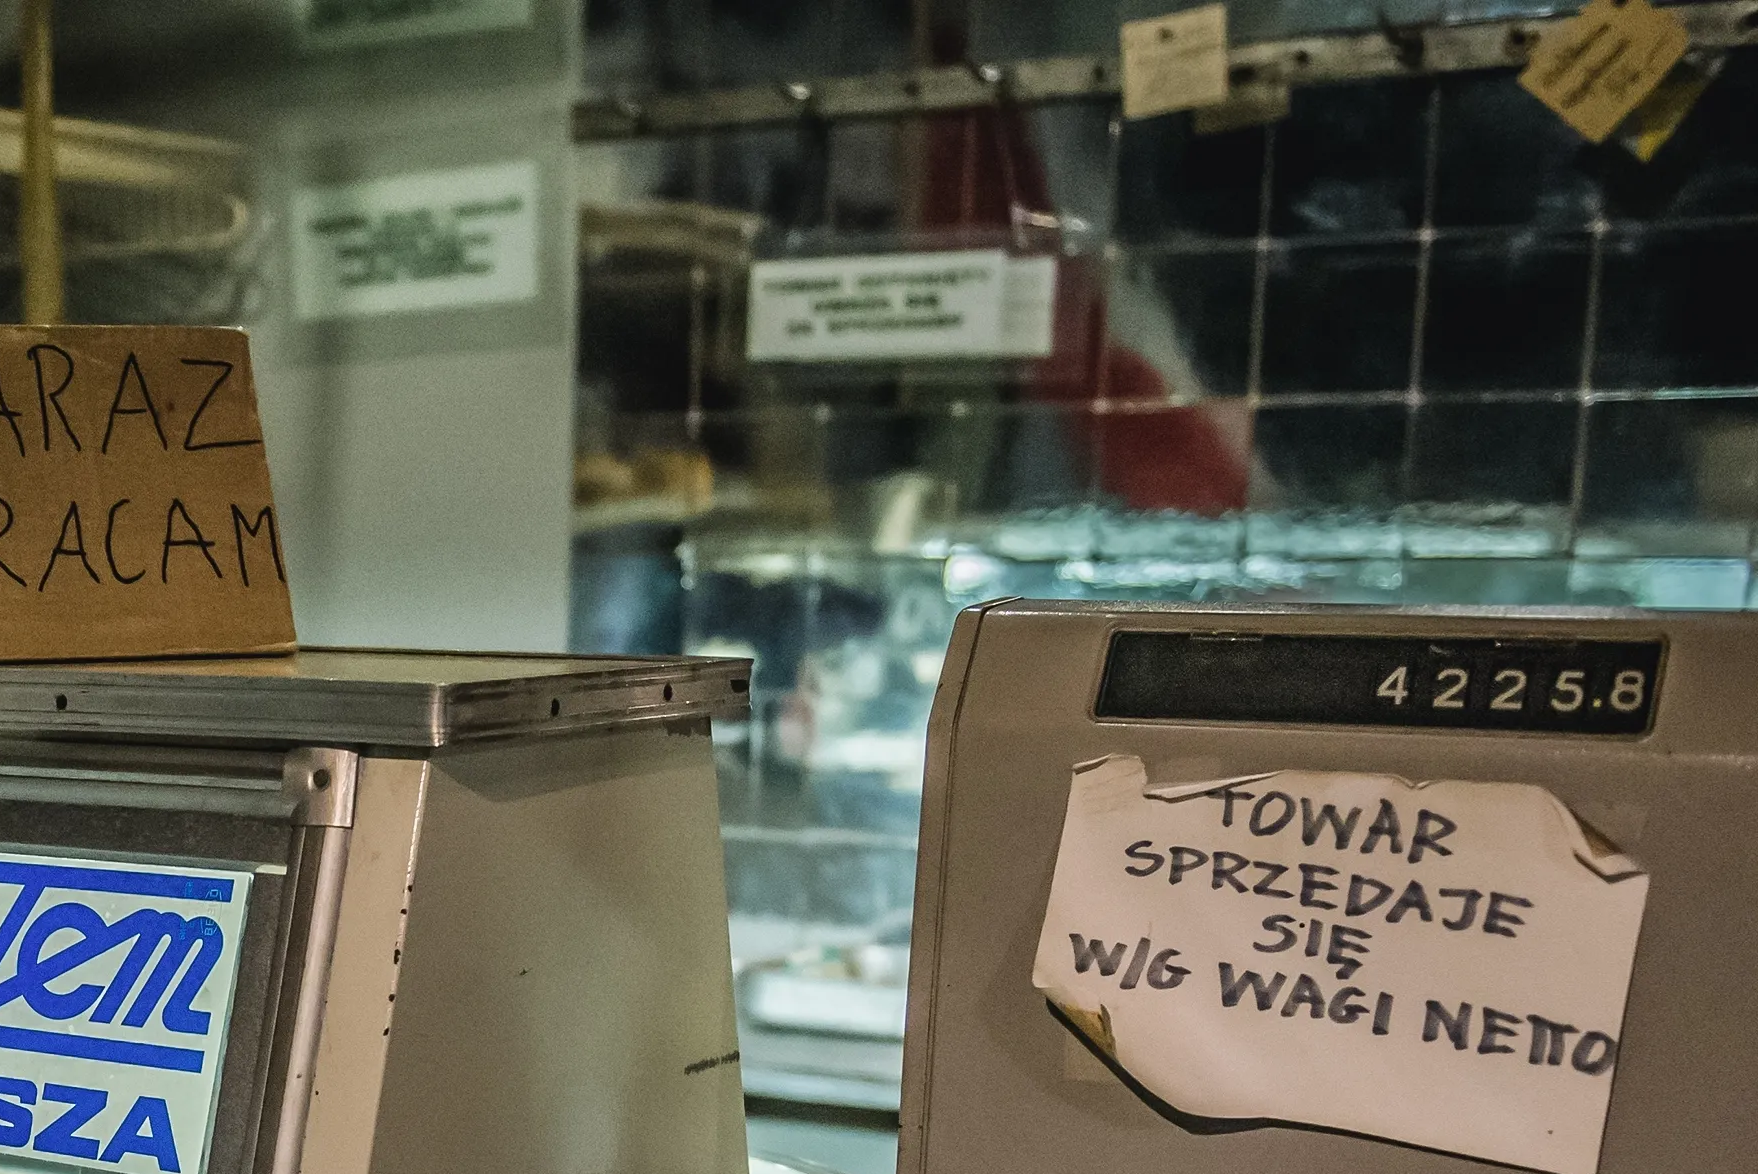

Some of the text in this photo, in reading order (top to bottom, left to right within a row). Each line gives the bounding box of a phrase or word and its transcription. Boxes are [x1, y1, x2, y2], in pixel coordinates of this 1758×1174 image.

[1203, 788, 1458, 864] TOWAR
[1123, 840, 1536, 938] SPRZEDAJE
[1251, 914, 1374, 980] SIĘ
[1068, 932, 1617, 1077] W/G WAGI NETTO
